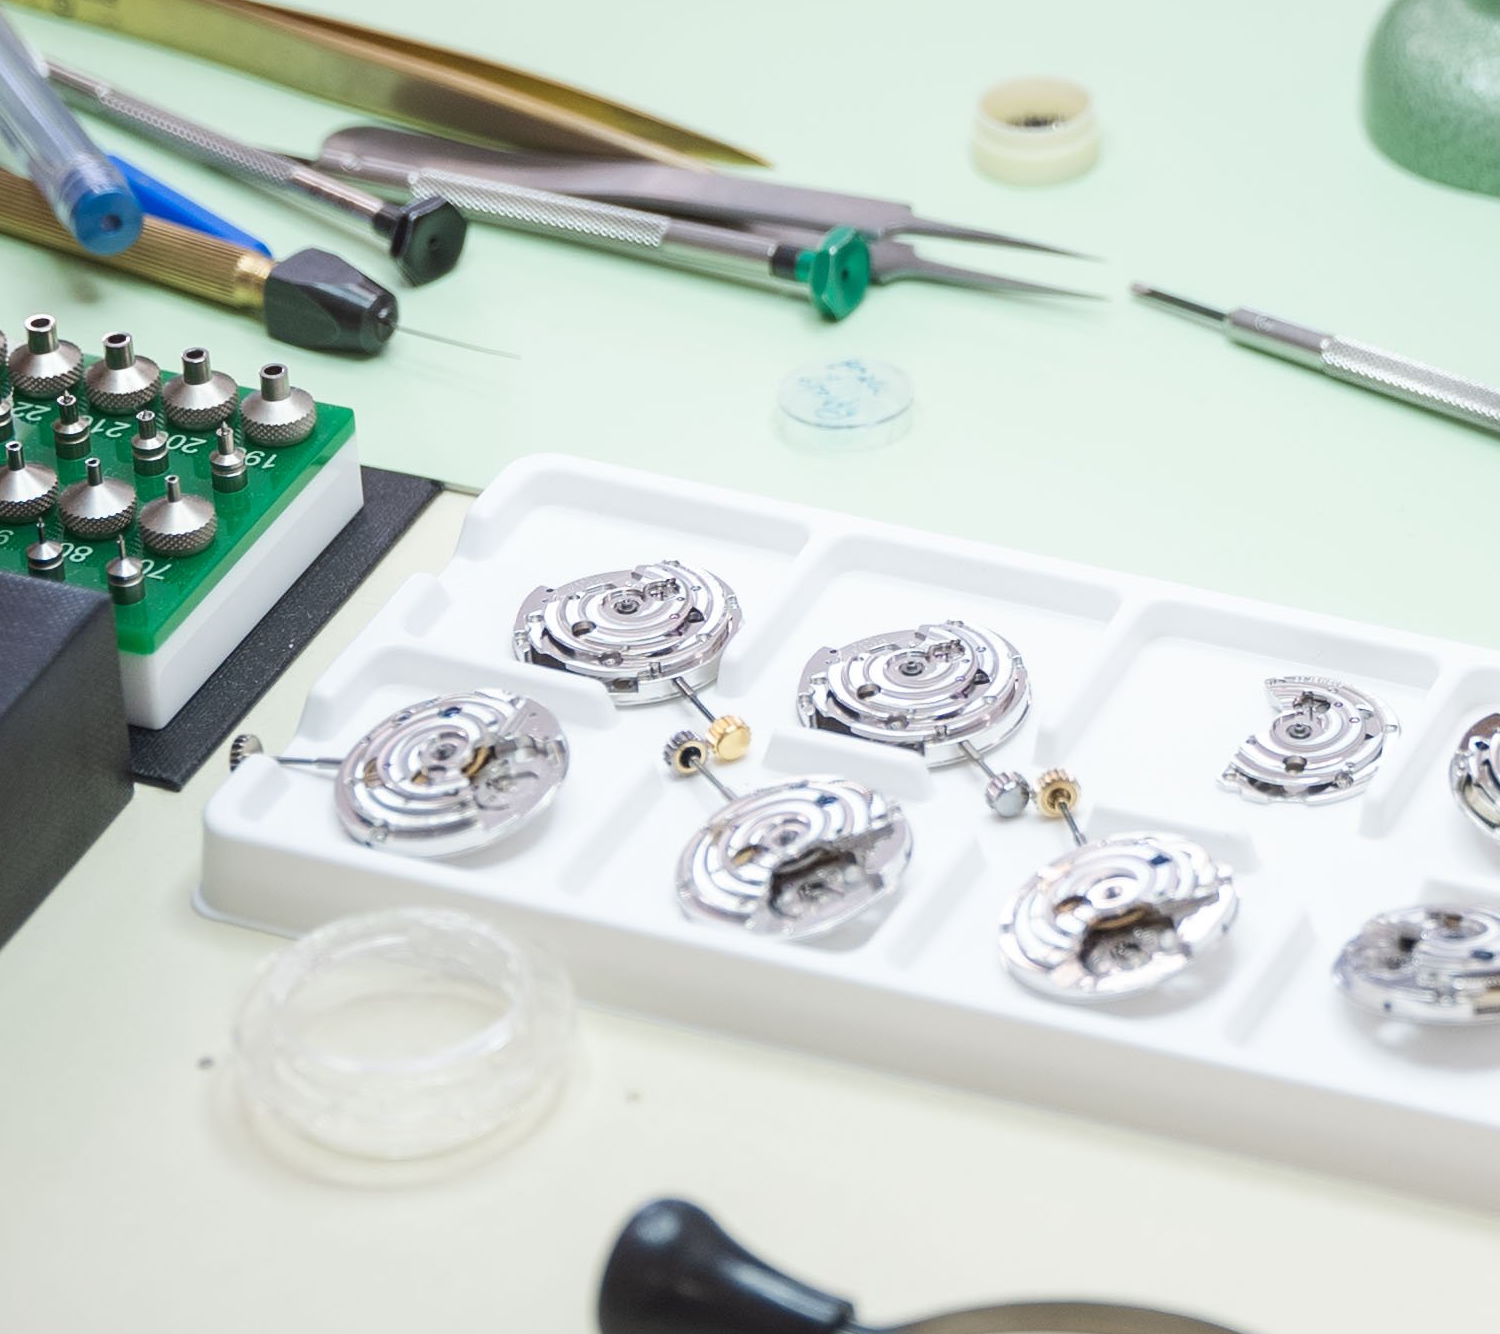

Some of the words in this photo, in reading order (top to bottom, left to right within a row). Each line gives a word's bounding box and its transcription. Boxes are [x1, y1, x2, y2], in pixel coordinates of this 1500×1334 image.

[10, 402, 52, 422] 22
[157, 431, 207, 454] 20
[236, 447, 277, 469] 19
